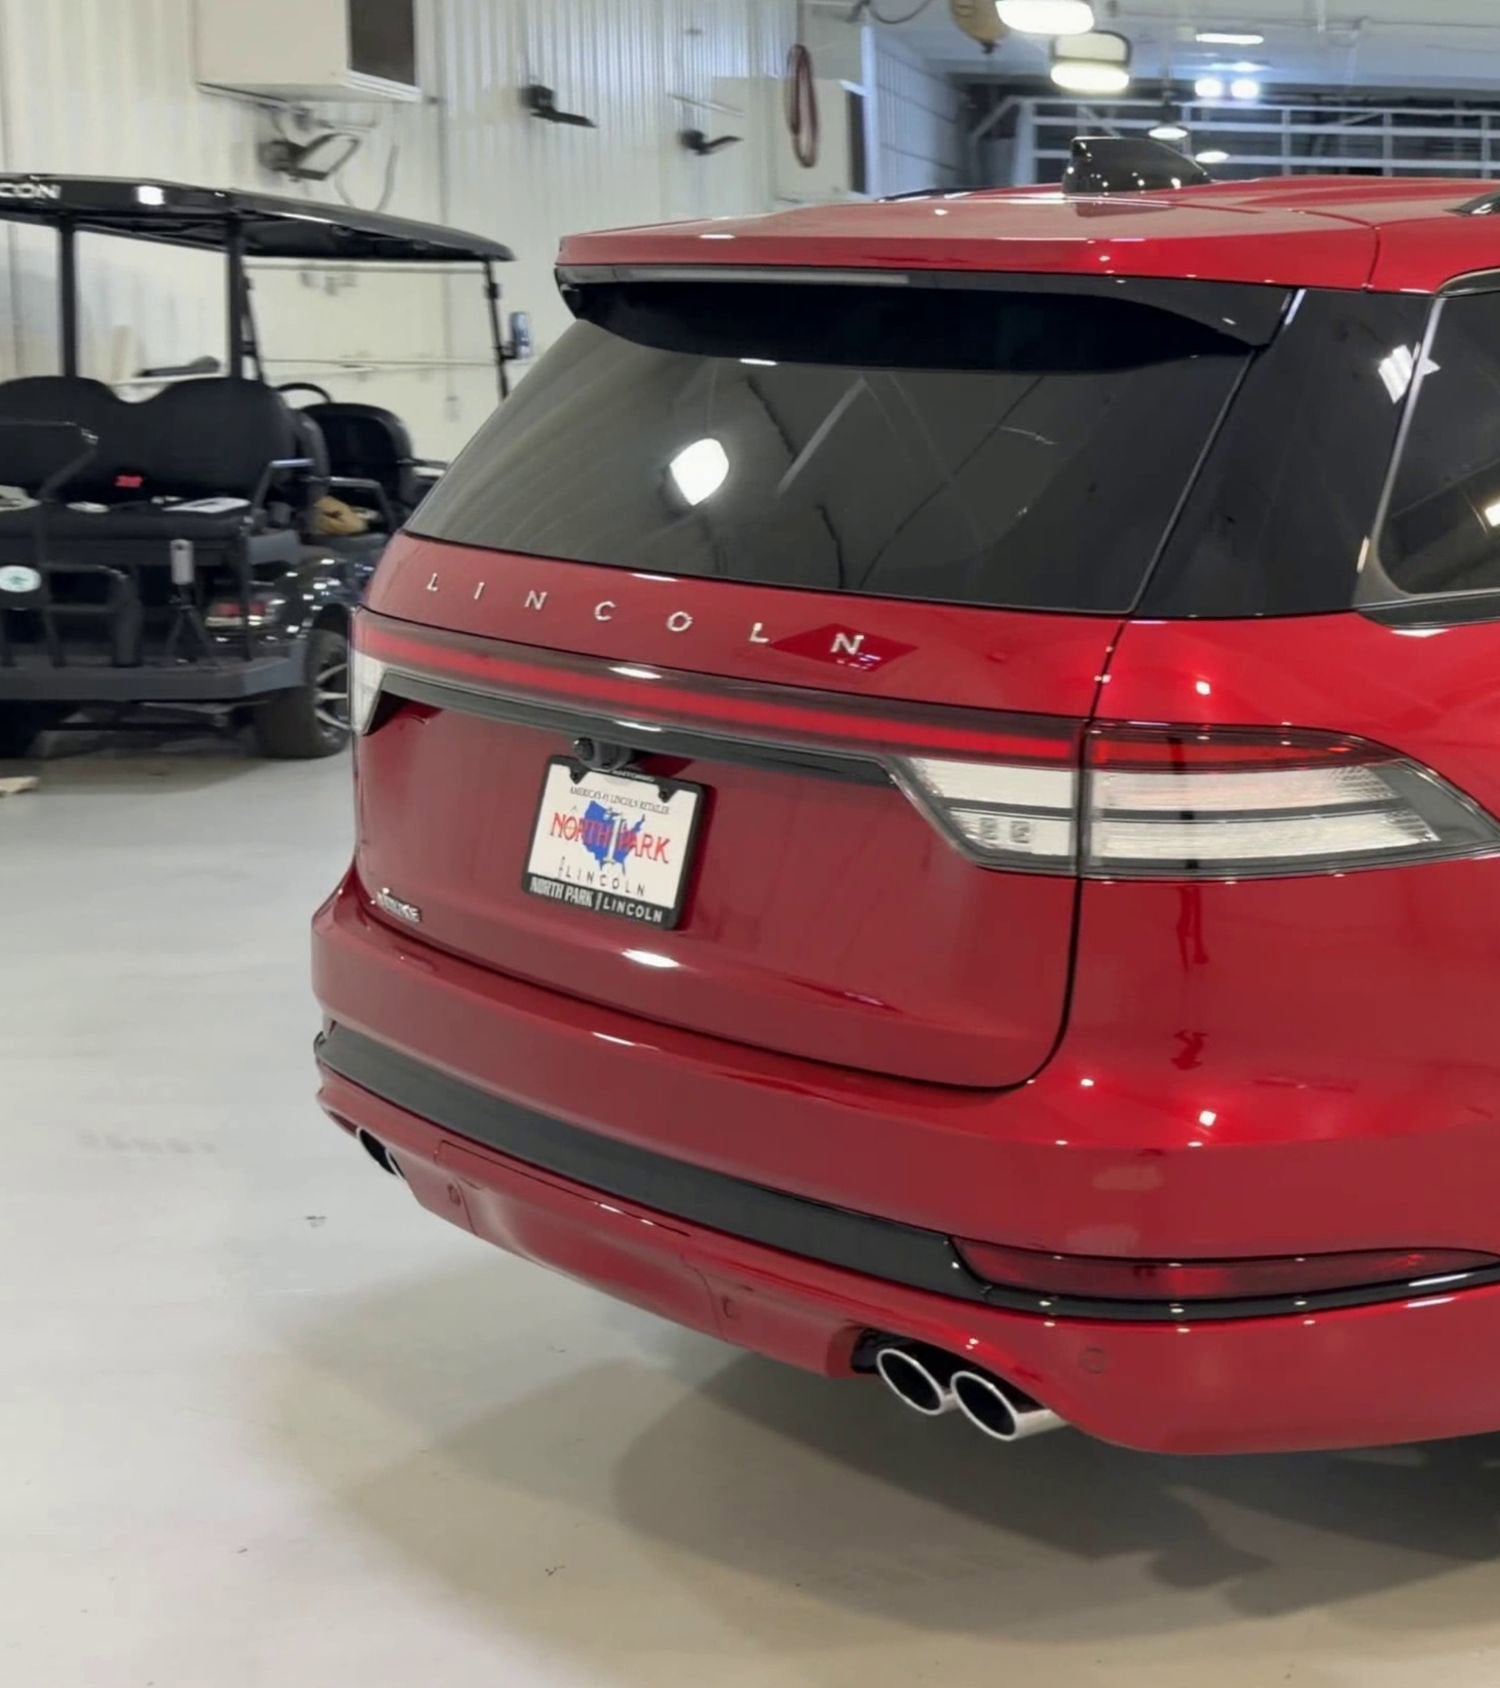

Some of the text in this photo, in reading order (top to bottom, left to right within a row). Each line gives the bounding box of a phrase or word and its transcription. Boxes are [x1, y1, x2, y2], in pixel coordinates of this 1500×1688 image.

[427, 572, 864, 655] LINCOLN
[549, 812, 671, 864] NORTH PARK
[529, 876, 663, 923] NORTH PARK LINCOLN
[565, 865, 646, 896] LINCOLN
